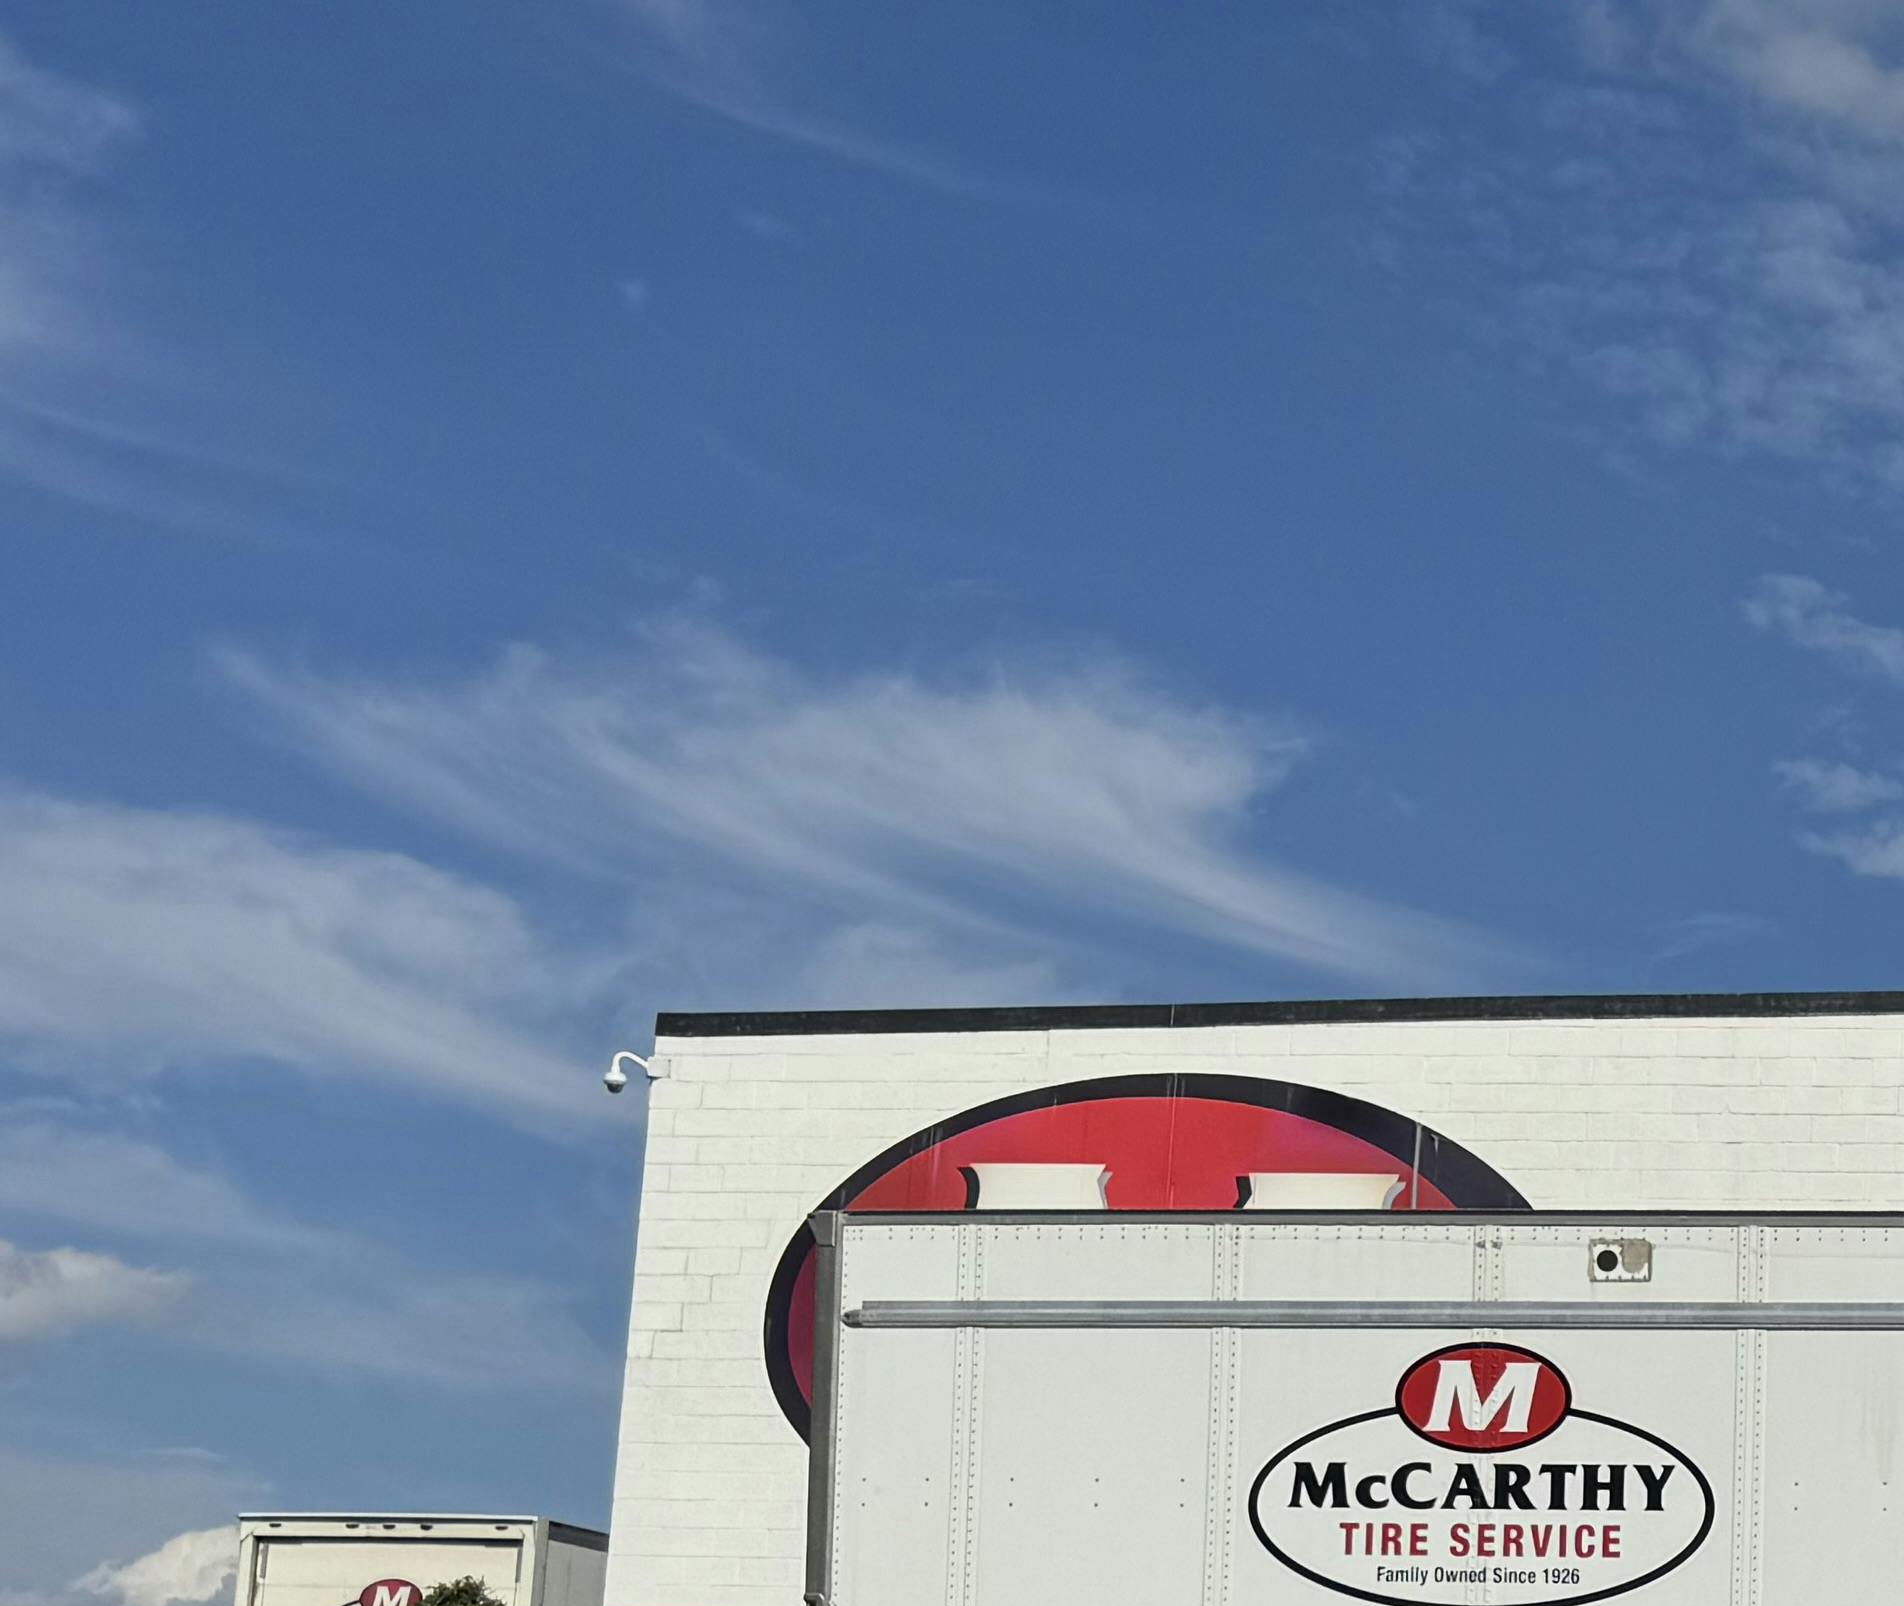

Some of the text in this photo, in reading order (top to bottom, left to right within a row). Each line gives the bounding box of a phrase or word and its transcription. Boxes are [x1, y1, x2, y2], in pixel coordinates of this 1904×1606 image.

[1421, 1360, 1542, 1434] M
[1287, 1462, 1676, 1511] McCARTHY
[1339, 1523, 1621, 1558] TIRE SERVICE
[1376, 1566, 1580, 1588] Family Owned Since 1926
